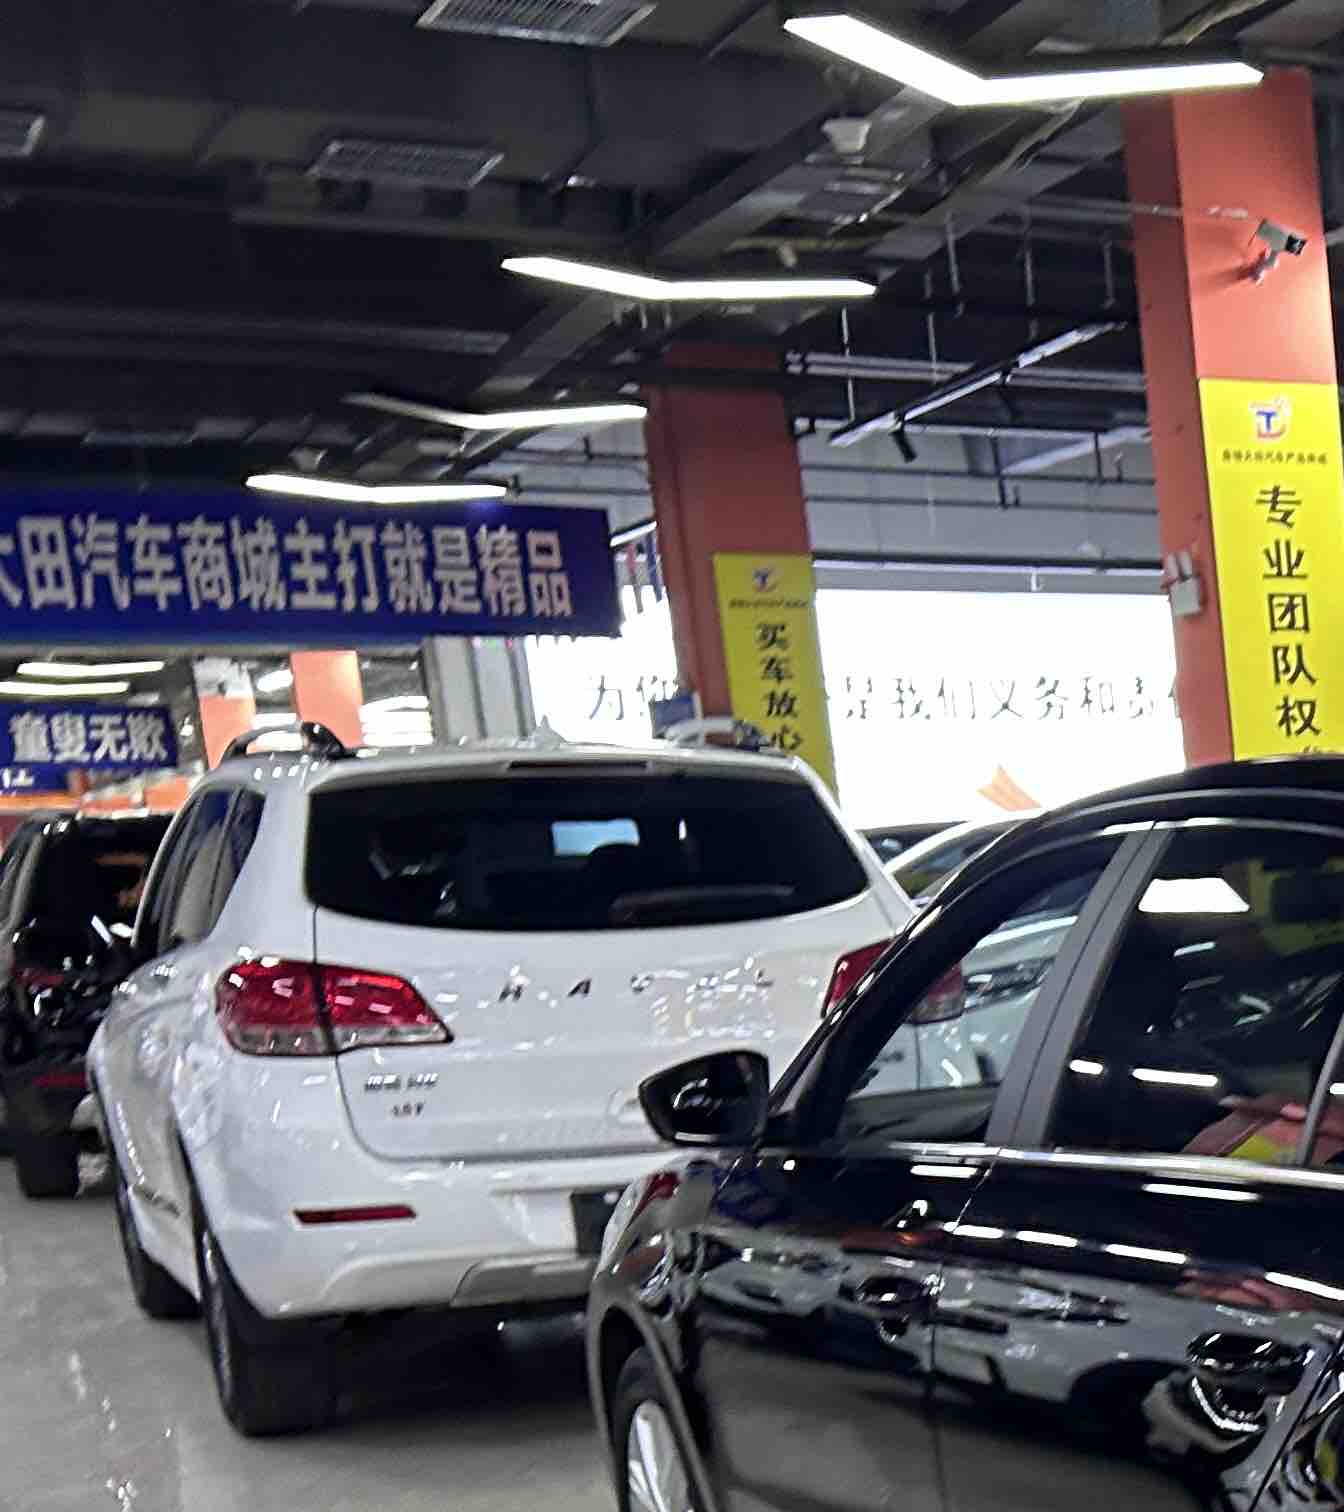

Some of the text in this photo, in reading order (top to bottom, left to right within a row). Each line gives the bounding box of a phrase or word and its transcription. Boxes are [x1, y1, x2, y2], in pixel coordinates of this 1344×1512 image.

[1255, 485, 1325, 752] 专业团队权
[9, 711, 169, 763] 童叟无欺
[757, 622, 804, 751] 买车放心
